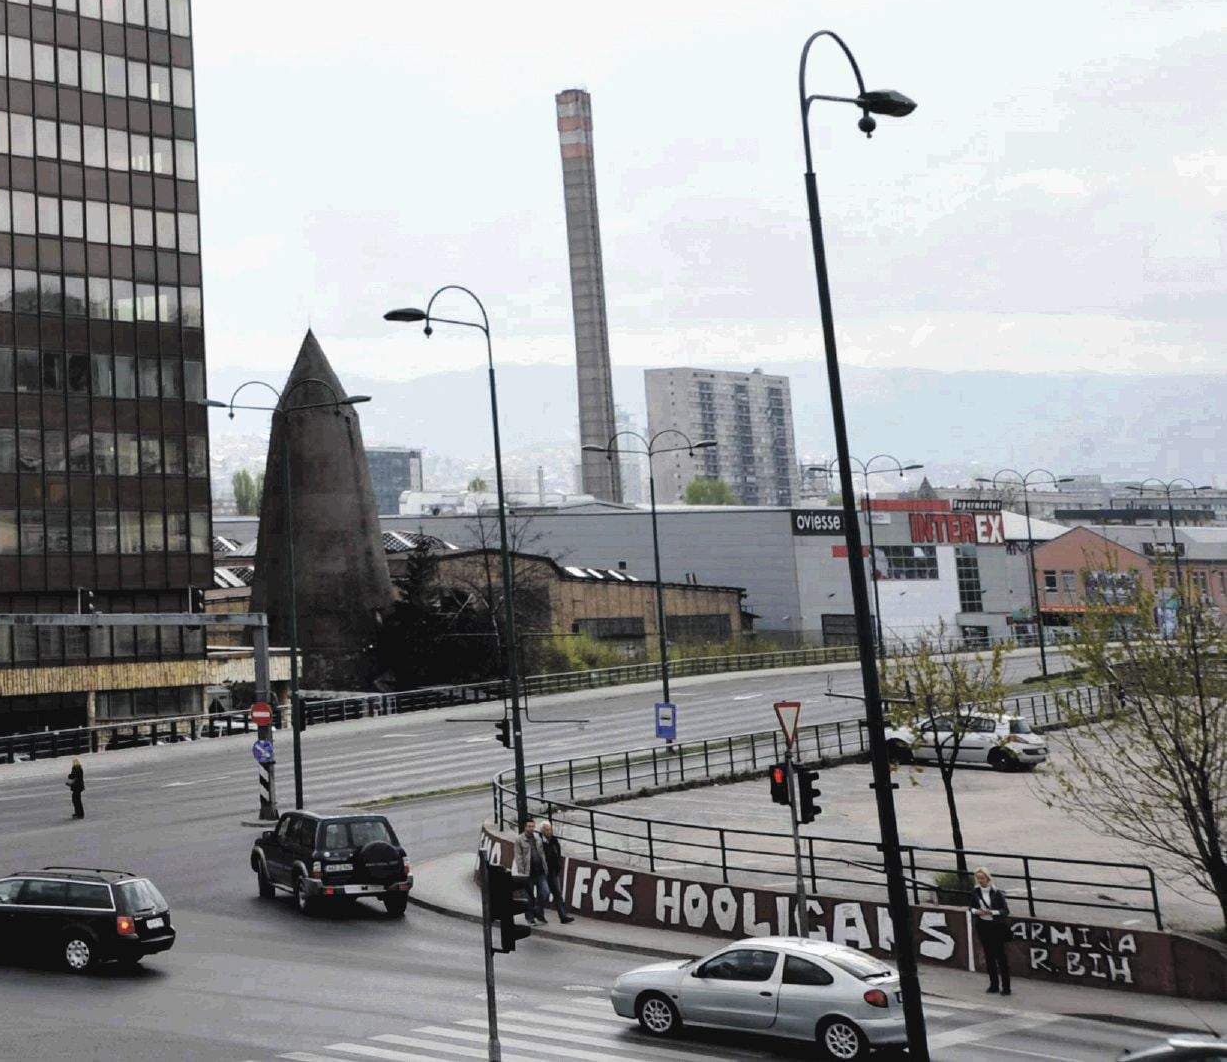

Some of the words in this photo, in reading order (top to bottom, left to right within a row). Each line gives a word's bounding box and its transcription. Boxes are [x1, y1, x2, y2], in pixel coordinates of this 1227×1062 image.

[796, 511, 841, 530] oviesse
[572, 866, 633, 916] FCS
[1010, 922, 1137, 955] ARMIJA
